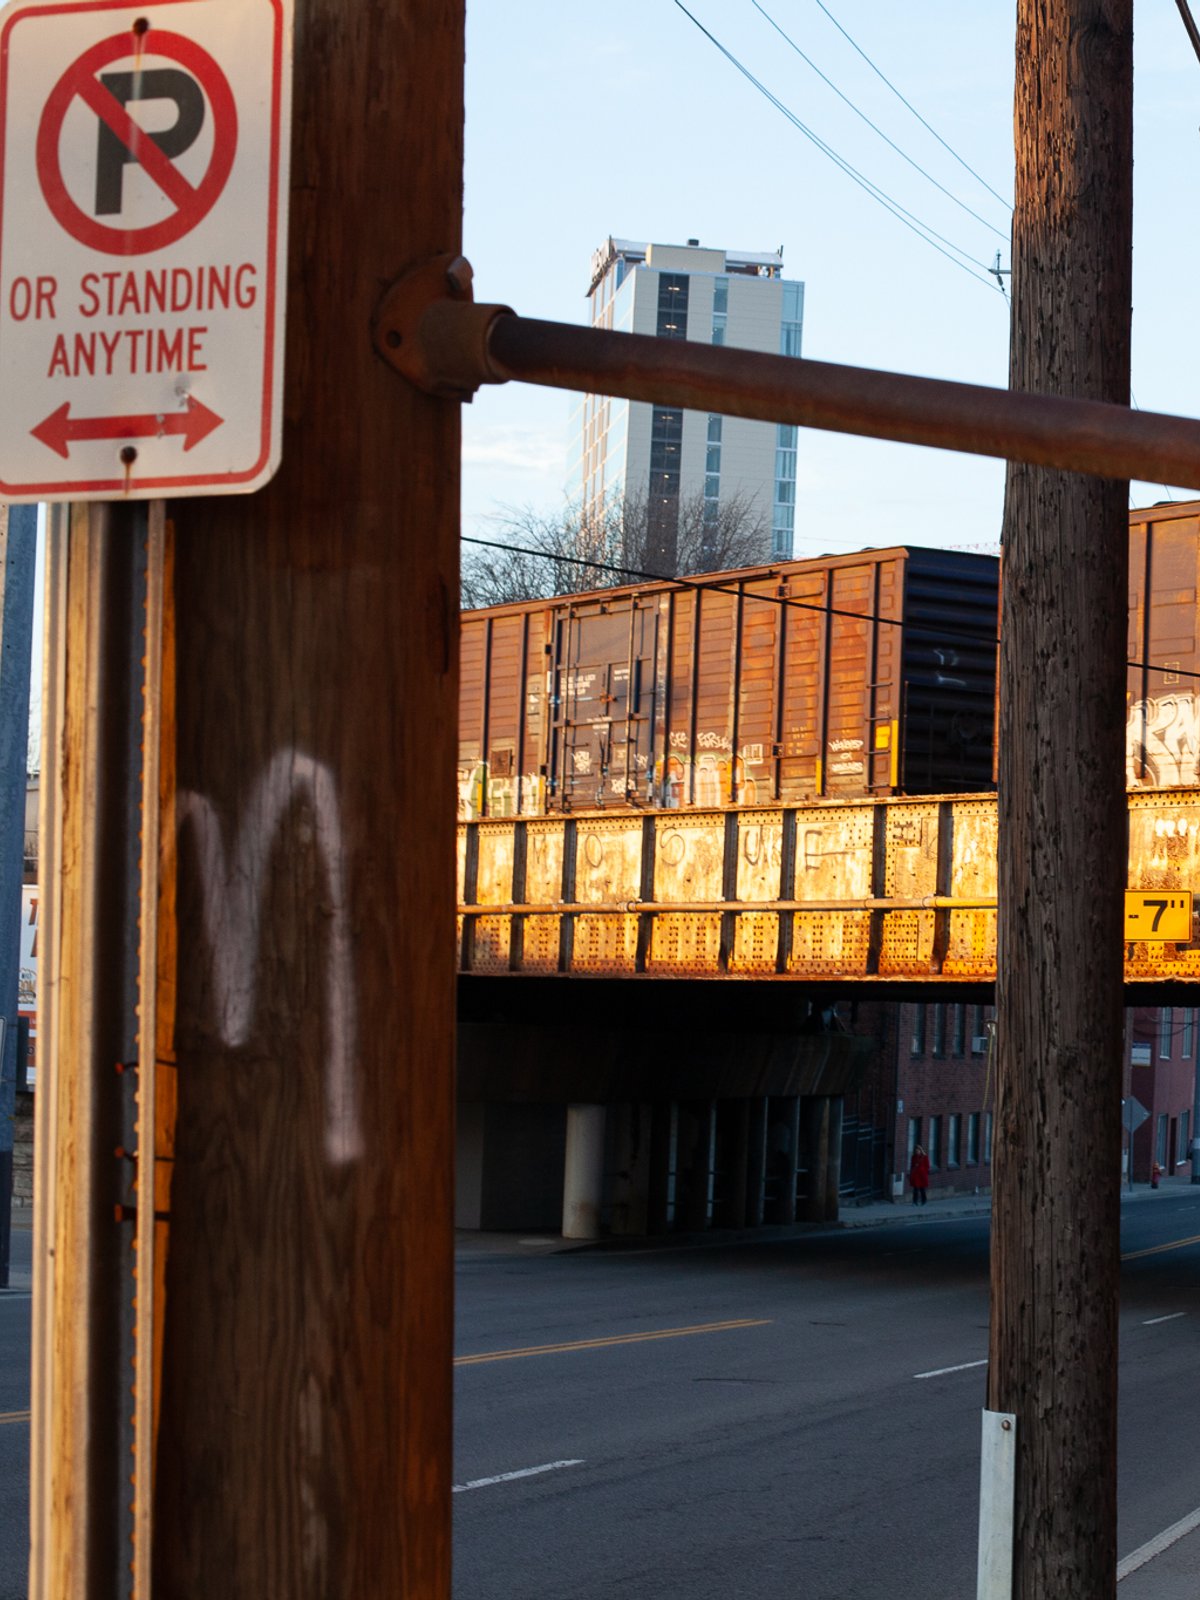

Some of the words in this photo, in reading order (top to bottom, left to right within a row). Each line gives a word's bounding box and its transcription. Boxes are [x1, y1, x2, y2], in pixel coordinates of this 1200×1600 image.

[9, 276, 58, 322] OR
[79, 263, 257, 319] STANDING
[47, 326, 209, 378] ANYTIME
